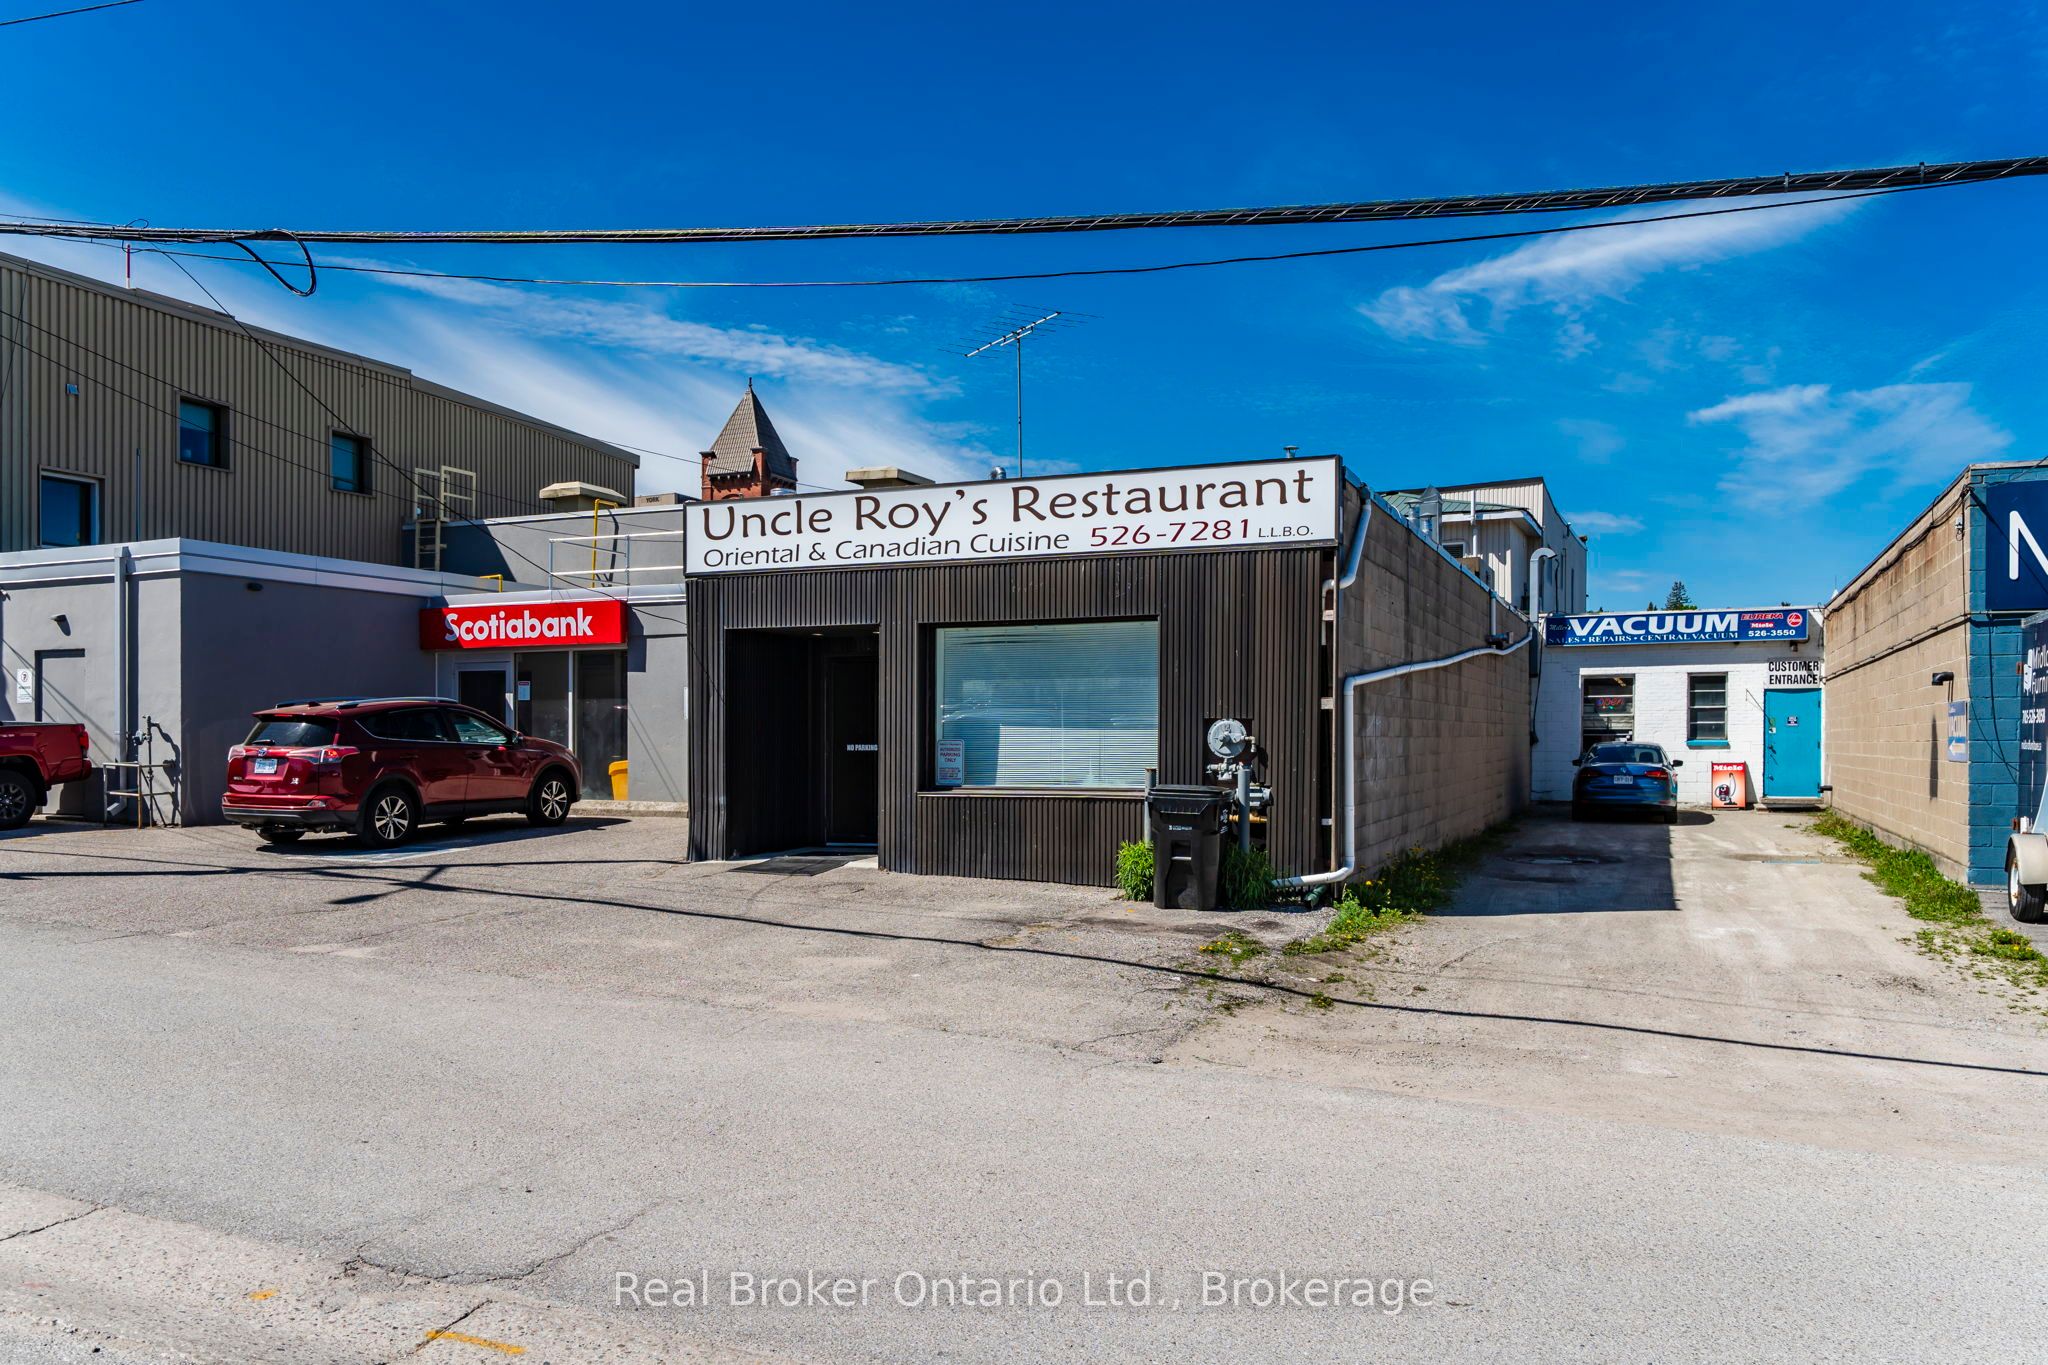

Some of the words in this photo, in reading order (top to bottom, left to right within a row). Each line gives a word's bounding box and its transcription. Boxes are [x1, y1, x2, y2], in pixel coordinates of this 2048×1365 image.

[703, 500, 833, 541] Uncle
[854, 489, 988, 536] Roy's
[1011, 469, 1314, 523] Restaurant
[703, 544, 800, 567] Oriental
[808, 542, 826, 561] &
[835, 537, 961, 560] Canadian
[970, 531, 1070, 553] Cuisine
[1090, 518, 1250, 547] 526-7281
[1258, 525, 1314, 538] L.L.B.O.
[444, 607, 594, 642] Scotiabank
[1568, 613, 1739, 636] VACUUM
[1748, 629, 1796, 637] 526-3550
[1548, 636, 1580, 644] SALES
[1588, 635, 1632, 643] REPAIRS
[1640, 633, 1691, 641] CENTRAL
[1692, 632, 1739, 640] VACUUM
[1768, 660, 1819, 672] CUSTOMER
[1769, 674, 1818, 685] ENTRANCE
